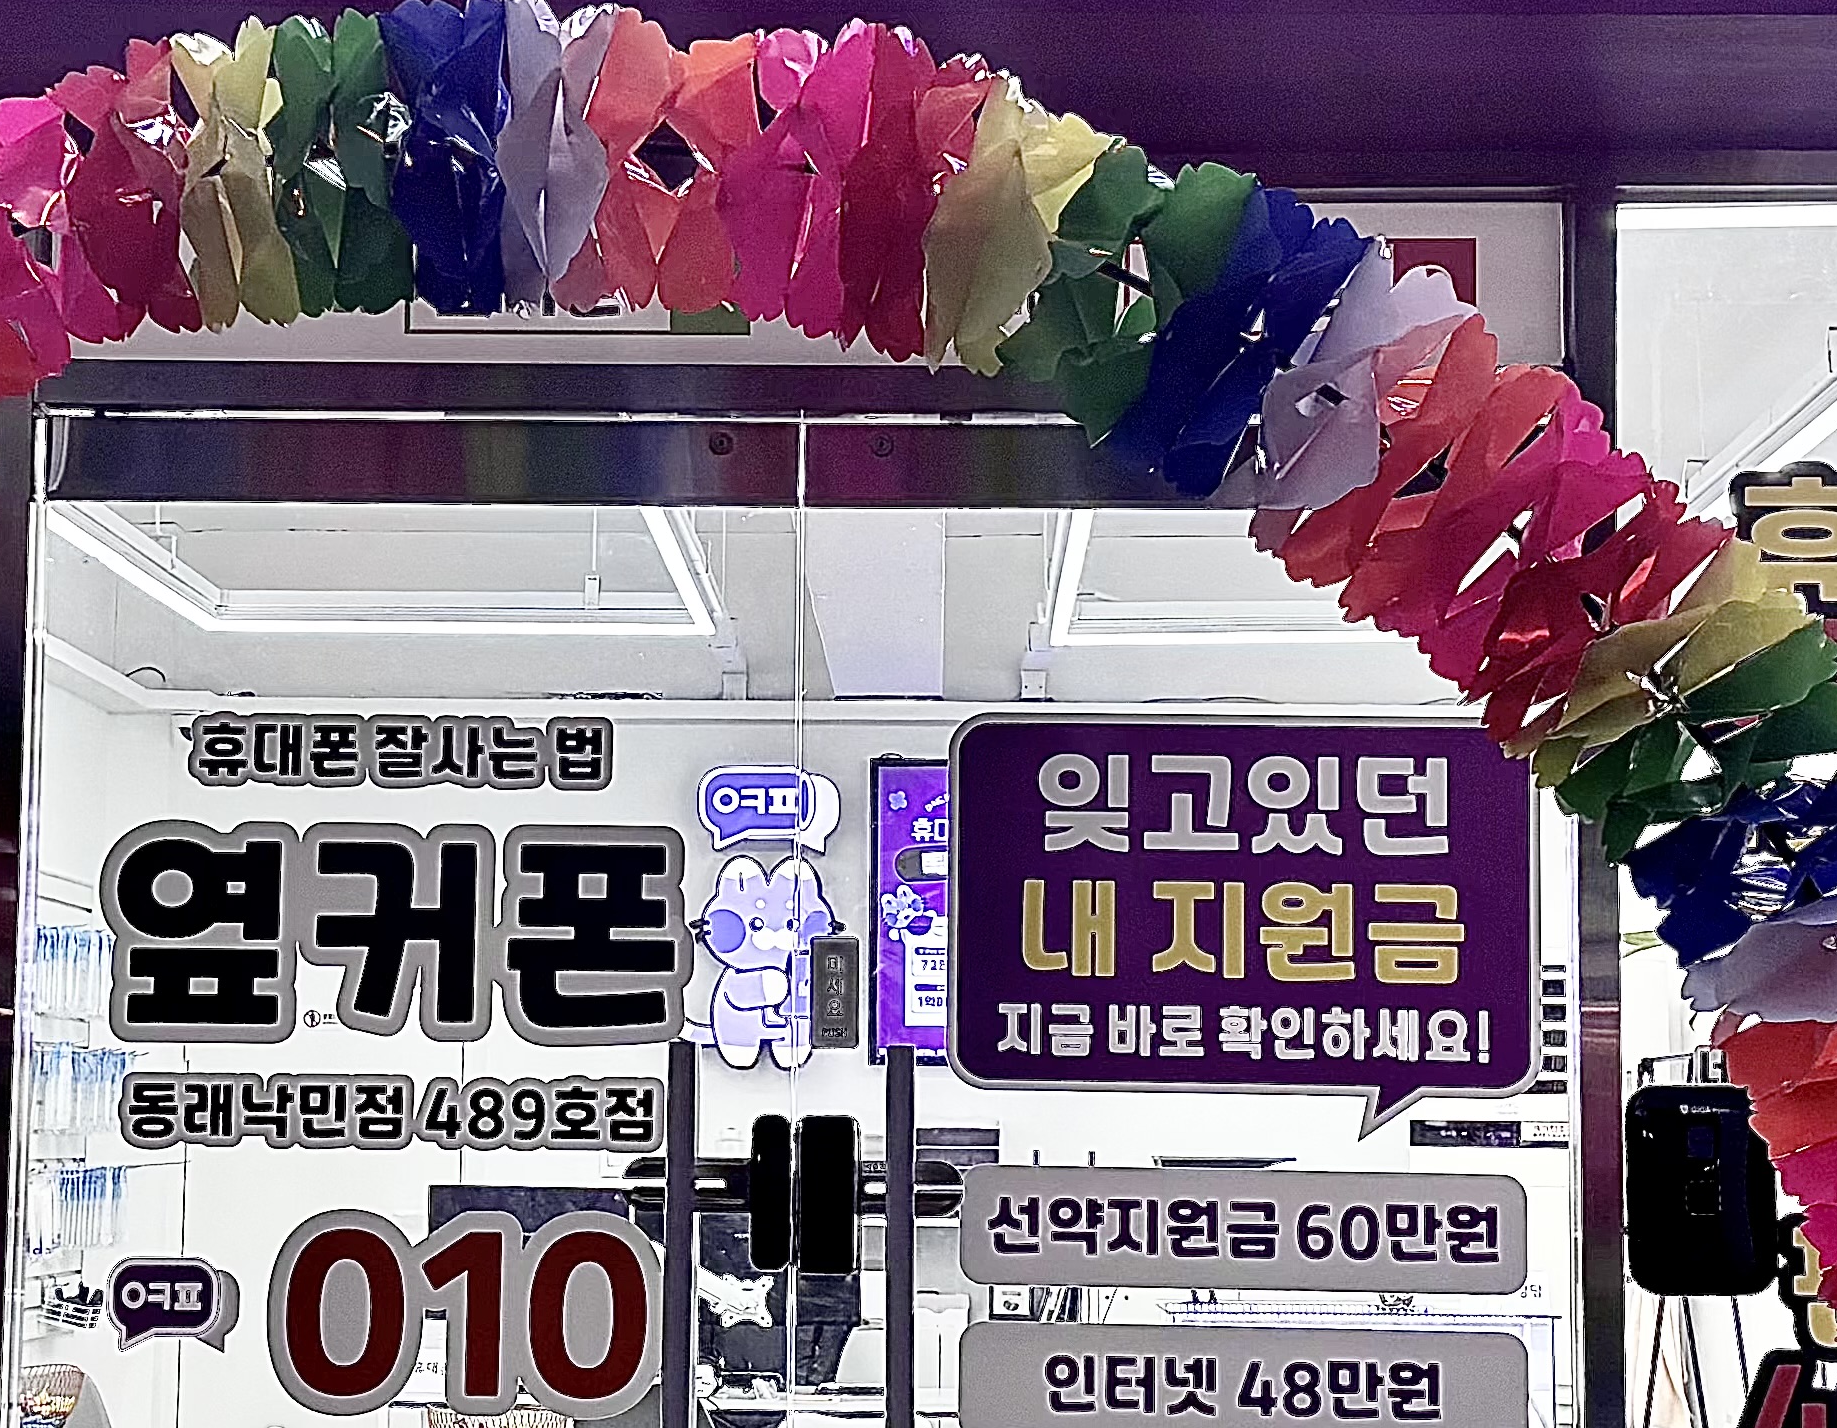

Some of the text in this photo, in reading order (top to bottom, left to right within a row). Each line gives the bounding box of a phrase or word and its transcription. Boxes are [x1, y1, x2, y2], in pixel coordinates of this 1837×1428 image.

[198, 723, 604, 781] 휴대폰 잘사는 법
[1038, 753, 1450, 859] 잊고있던
[116, 836, 676, 1030] 옆커폰
[1021, 879, 1467, 987] 내 지원금
[997, 1002, 1491, 1065] 지금 바로 확인하세요!
[127, 1082, 656, 1143] 동래낙민점 489호점
[987, 1194, 1501, 1265] 선약지원금 60만원
[285, 1227, 649, 1402] 010
[1044, 1353, 1443, 1421] 인터넷 48만원
